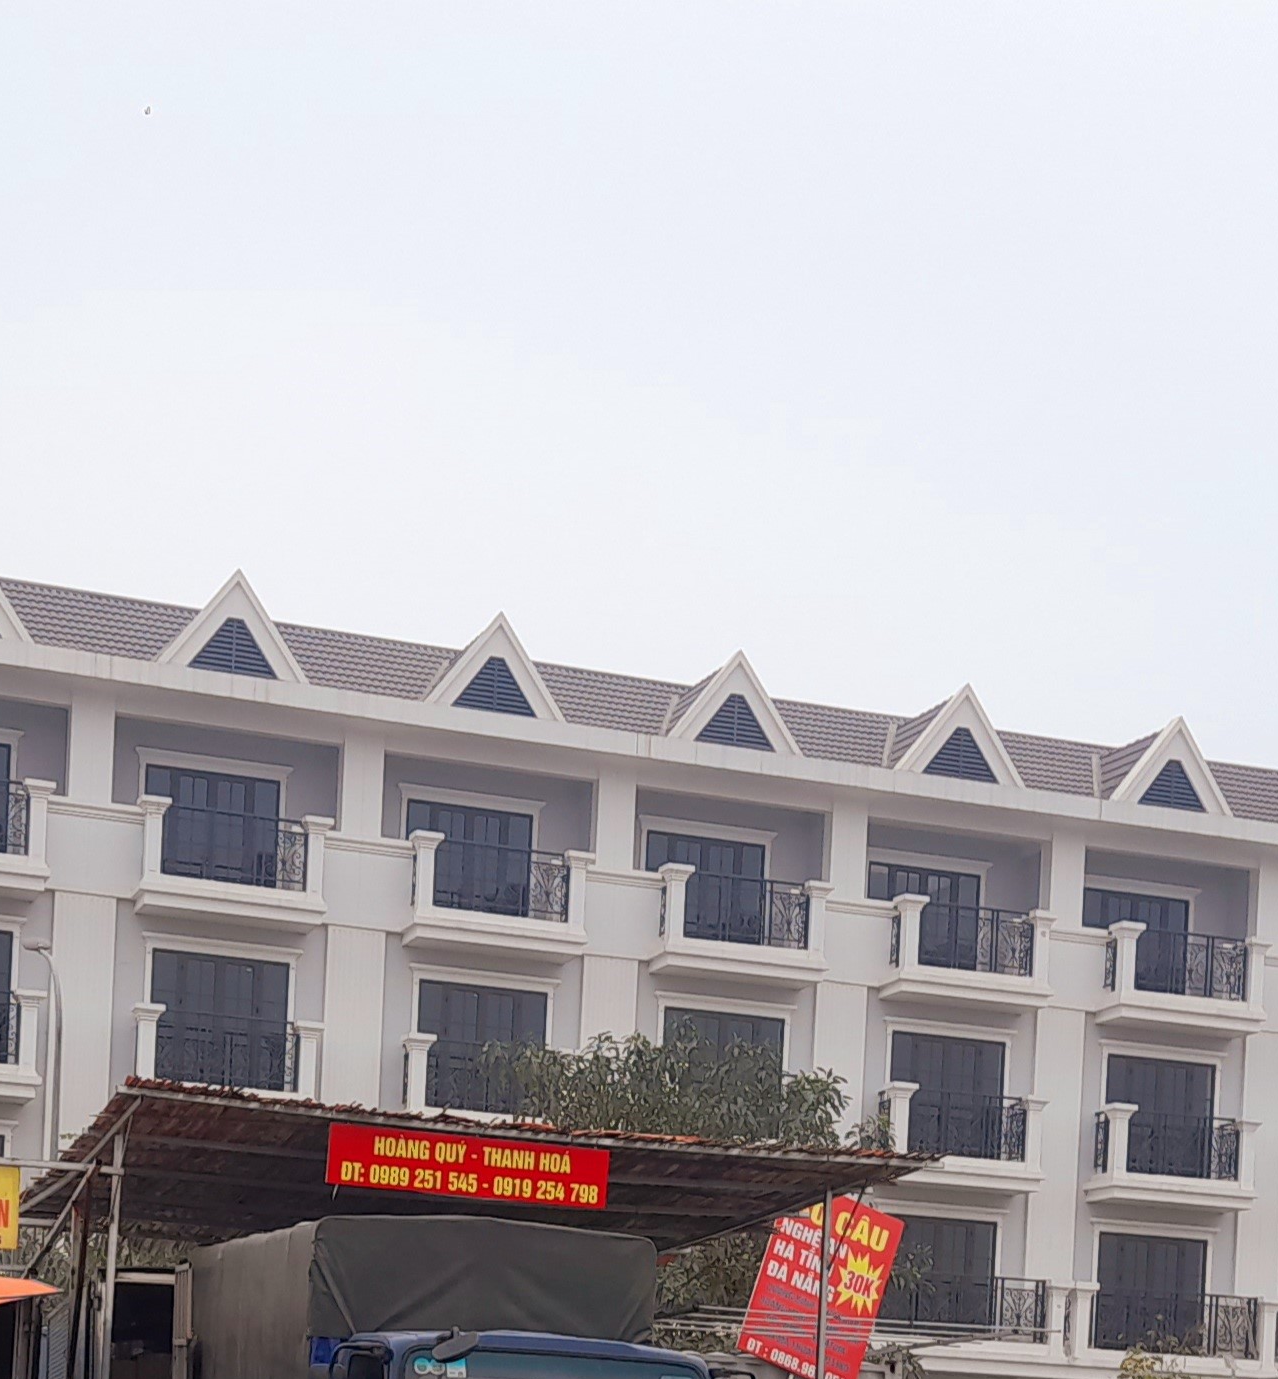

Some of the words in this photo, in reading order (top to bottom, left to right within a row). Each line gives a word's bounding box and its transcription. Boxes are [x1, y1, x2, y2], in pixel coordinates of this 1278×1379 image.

[374, 1134, 430, 1160] HOÀNG
[435, 1139, 467, 1164] QUÝ
[483, 1146, 535, 1171] THANH
[340, 1161, 365, 1183] ĐT:
[369, 1164, 410, 1187] 0989
[413, 1169, 442, 1190] 251
[448, 1172, 478, 1193] 545
[493, 1176, 532, 1198] 0919
[536, 1181, 565, 1201] 254
[570, 1183, 599, 1205] 798
[835, 1211, 890, 1252] CÂU
[773, 1238, 795, 1261] HÀ
[766, 1259, 789, 1283] ĐÀ
[843, 1270, 874, 1299] 30K
